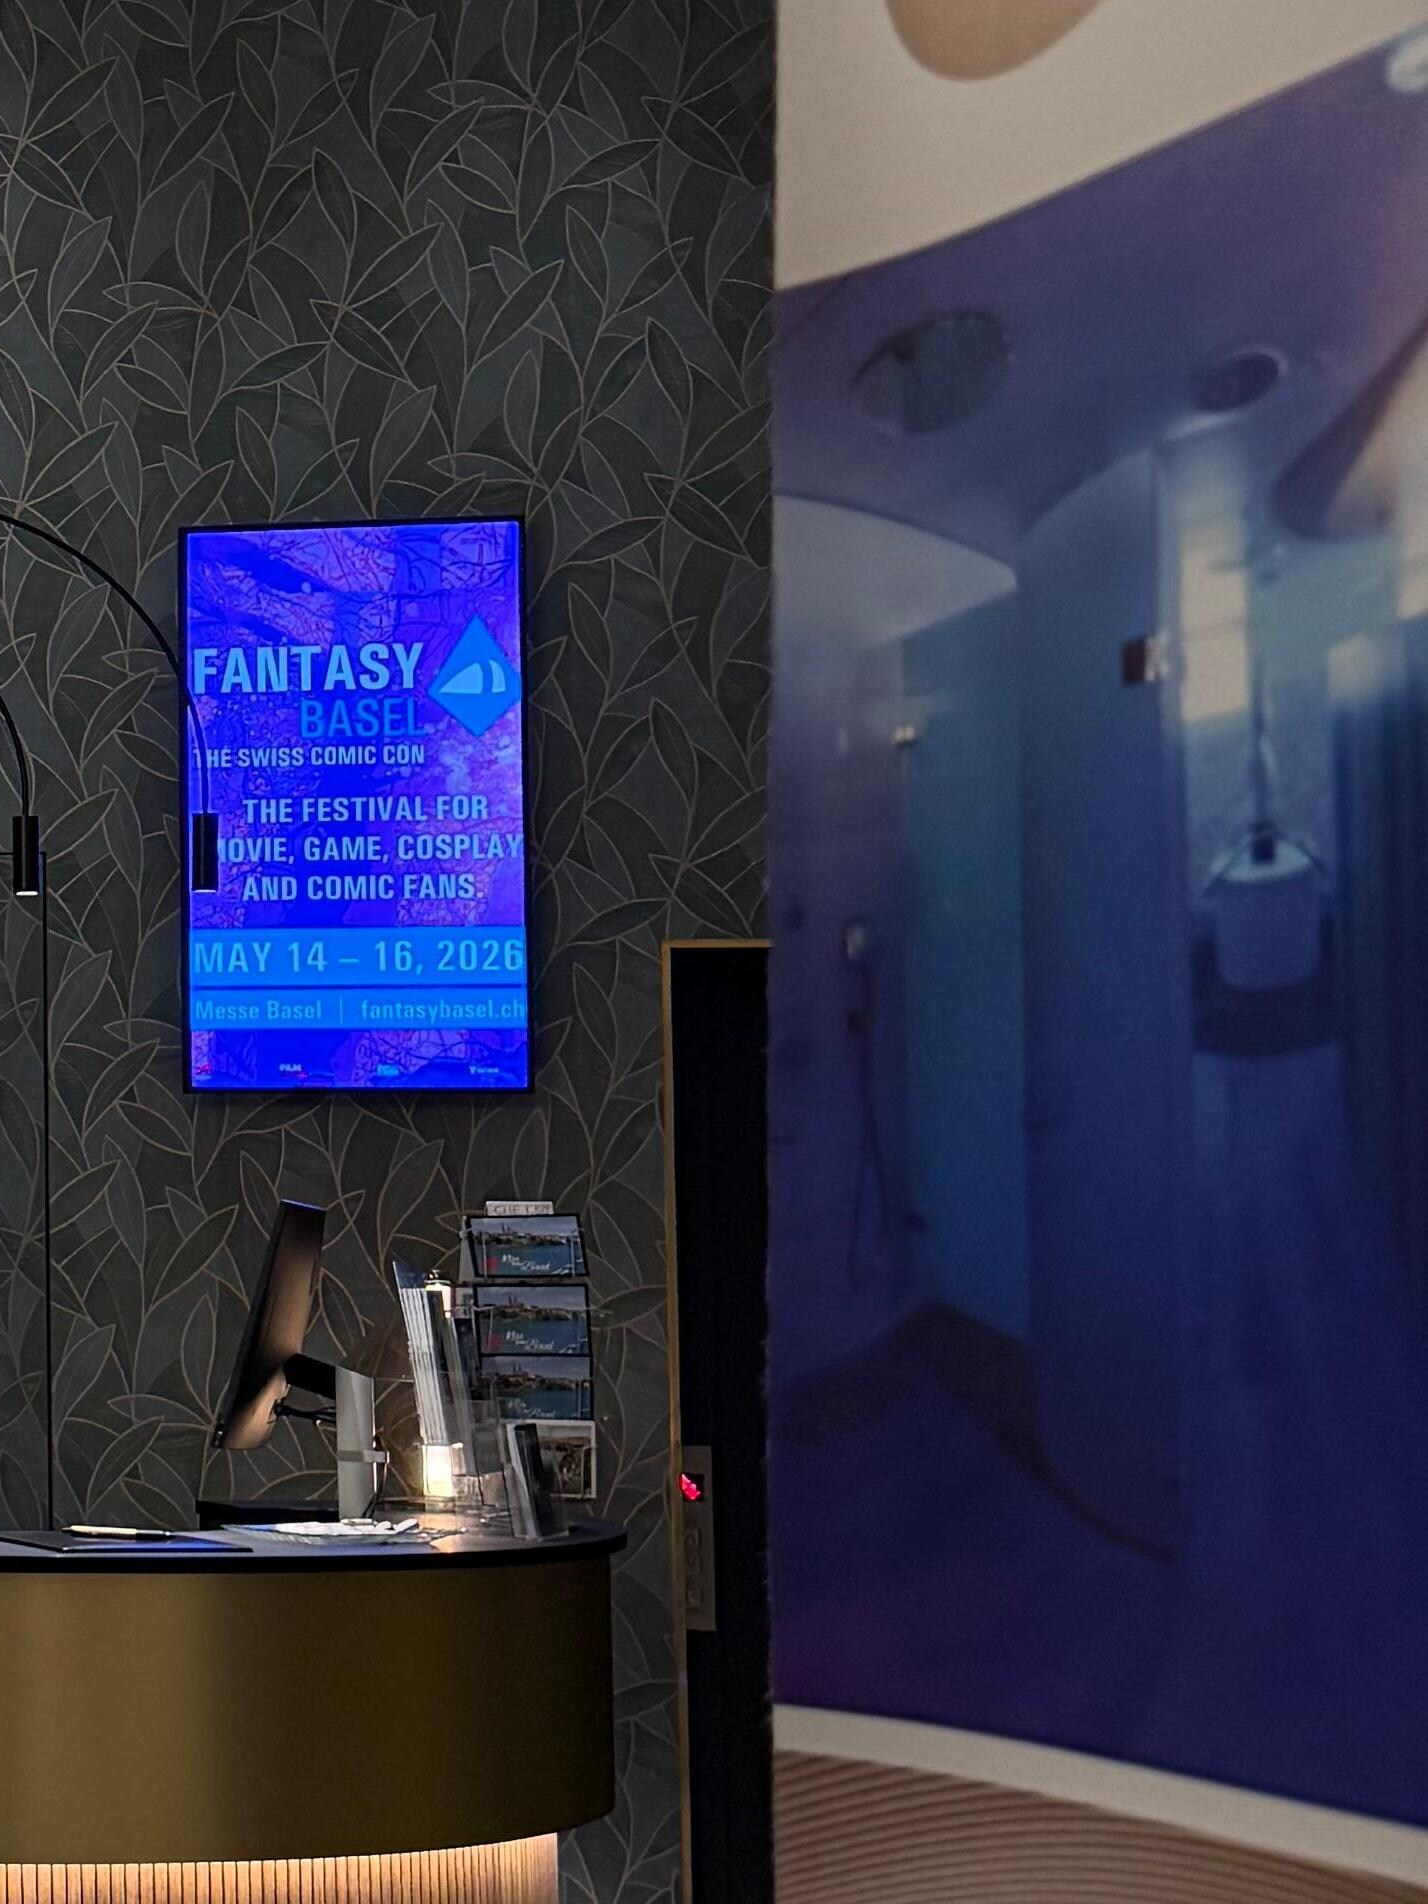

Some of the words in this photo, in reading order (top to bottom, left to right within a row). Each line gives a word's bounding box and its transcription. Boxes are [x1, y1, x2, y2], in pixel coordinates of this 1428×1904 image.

[194, 642, 424, 694] FANTASY
[301, 698, 425, 738] BASEL
[238, 746, 304, 768] SWISS
[311, 745, 377, 766] COMIC
[383, 744, 425, 765] CON
[244, 798, 293, 823] THE
[302, 796, 427, 822] FESTIVAL
[436, 794, 489, 820] FOR
[304, 835, 389, 863] GAME,
[398, 834, 525, 859] COSPLAY
[244, 876, 298, 902] AND
[307, 874, 394, 900] COMIC
[404, 873, 485, 899] FANS.
[195, 942, 272, 974] MAY
[288, 941, 328, 973] 14
[374, 940, 424, 976] 16,
[437, 939, 524, 972] 2026
[195, 999, 260, 1021] Messe
[267, 998, 322, 1020] Basel
[361, 996, 526, 1025] fantasybasel.ch
